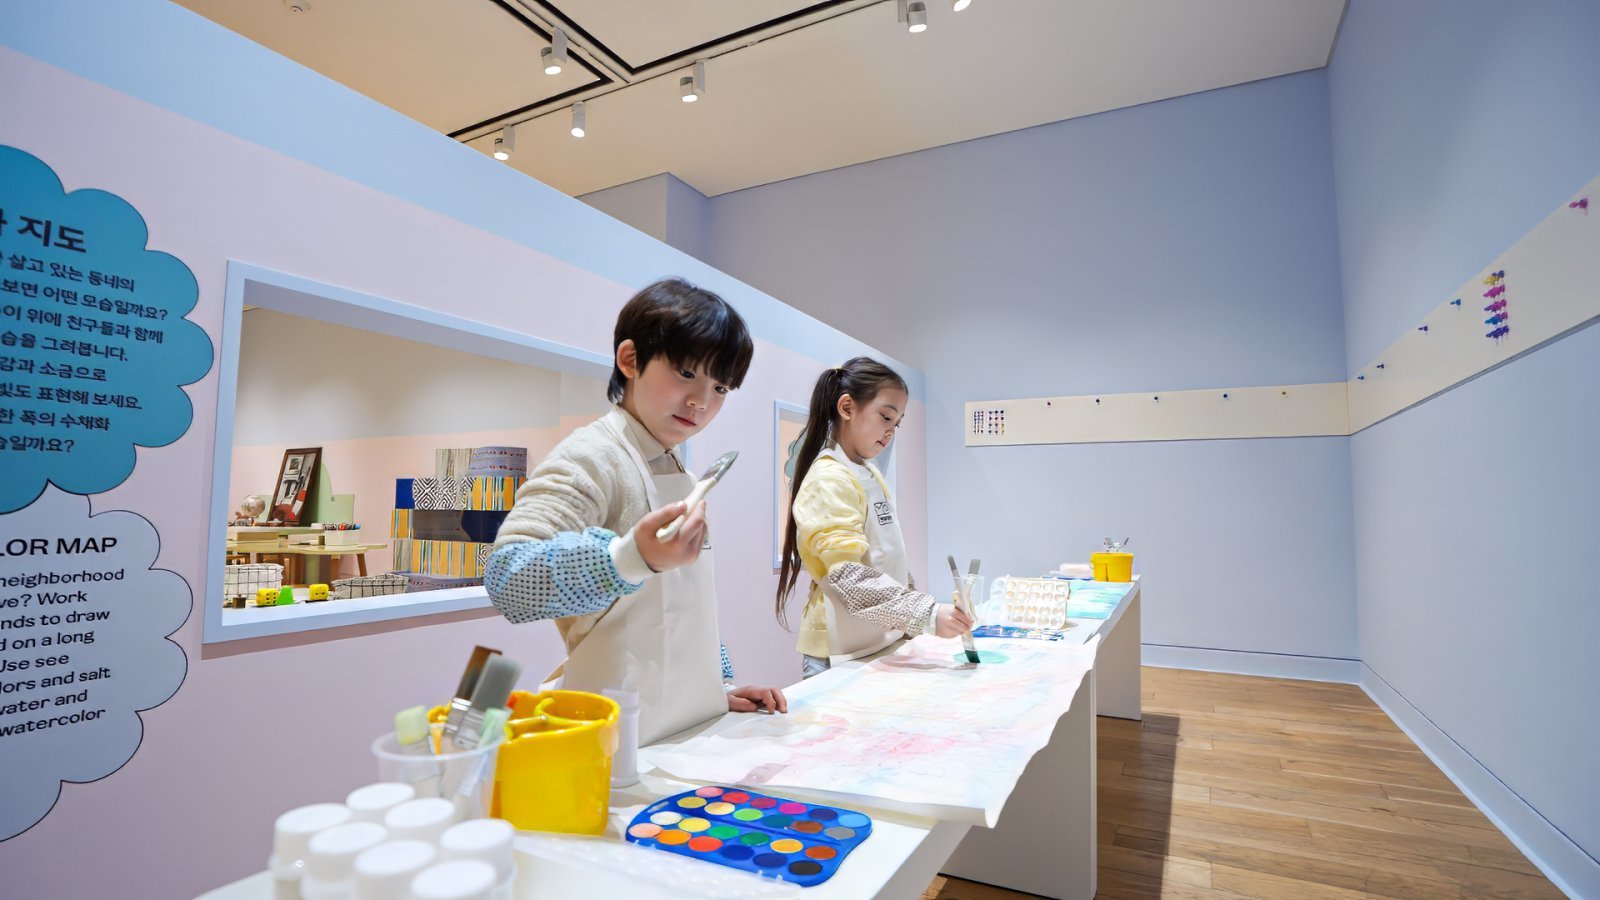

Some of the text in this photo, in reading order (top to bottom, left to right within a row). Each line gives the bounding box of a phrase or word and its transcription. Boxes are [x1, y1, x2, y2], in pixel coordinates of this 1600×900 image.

[17, 215, 87, 253] 지도
[8, 253, 44, 273] 살고
[50, 262, 83, 282] 있는
[88, 270, 135, 293] 동네의
[0, 278, 168, 320] 보면 어떤 모습일까요?
[0, 304, 163, 344] 이 위에 친구들과 함께
[1, 330, 128, 361] 습을 그려봅니다.
[39, 361, 107, 381] 소금으로
[36, 387, 89, 405] 표현해
[20, 410, 55, 427] 폭의
[60, 413, 110, 431] 수채화
[0, 537, 117, 557] OR MAP
[37, 590, 87, 605] Work
[1, 610, 110, 630] nds to draw
[12, 638, 36, 650] on
[41, 636, 52, 646] a
[57, 631, 95, 645] long
[35, 654, 69, 668] see
[41, 671, 74, 688] and
[55, 689, 87, 706] and
[0, 708, 105, 737] watercolor
